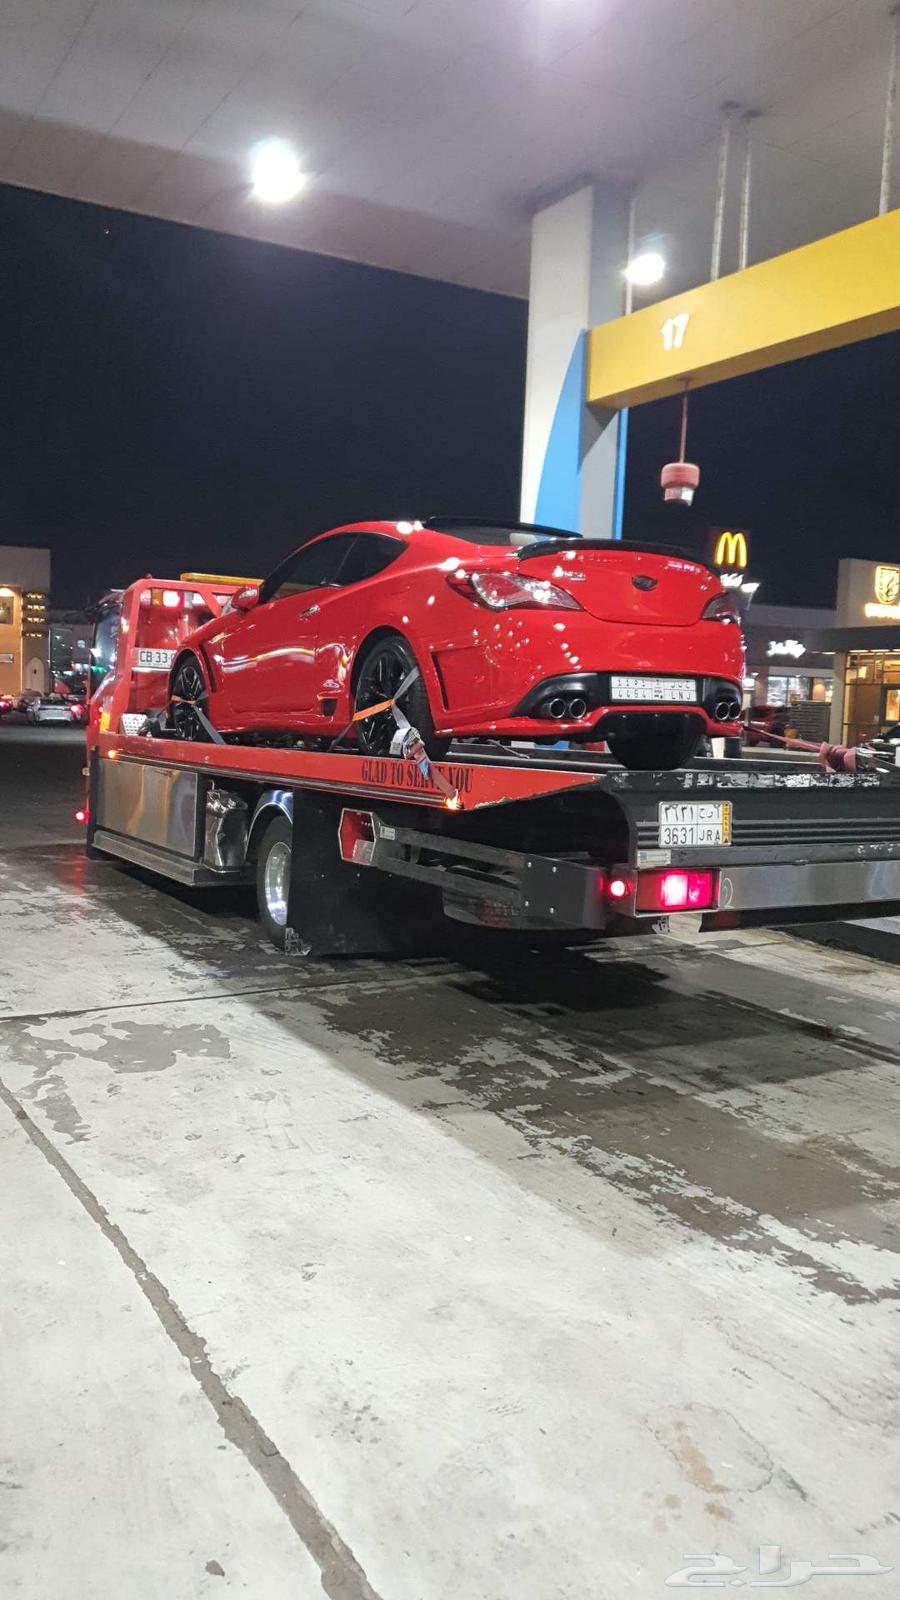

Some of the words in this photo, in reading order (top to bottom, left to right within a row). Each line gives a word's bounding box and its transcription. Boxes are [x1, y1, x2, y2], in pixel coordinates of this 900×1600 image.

[660, 313, 690, 351] 17
[361, 759, 387, 784] GLAD
[391, 762, 404, 785] TO
[448, 766, 474, 793] YOU
[664, 827, 694, 845] 3631
[699, 829, 721, 841] JRA
